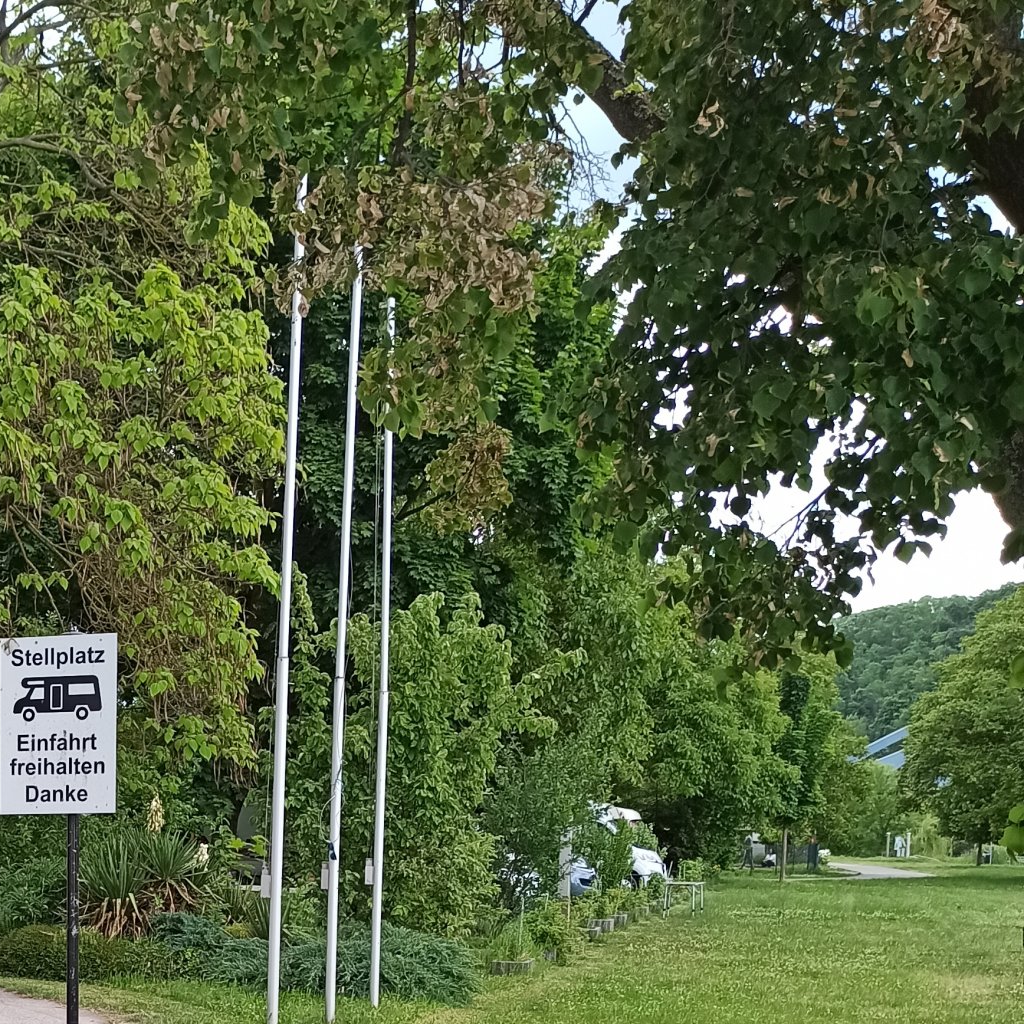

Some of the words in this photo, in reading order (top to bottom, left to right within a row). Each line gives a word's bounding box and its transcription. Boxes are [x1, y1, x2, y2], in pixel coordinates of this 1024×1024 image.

[11, 647, 105, 669] Stellplatz
[17, 733, 97, 752] Einfahrt
[10, 757, 105, 775] freihalten
[26, 785, 88, 803] Danke
